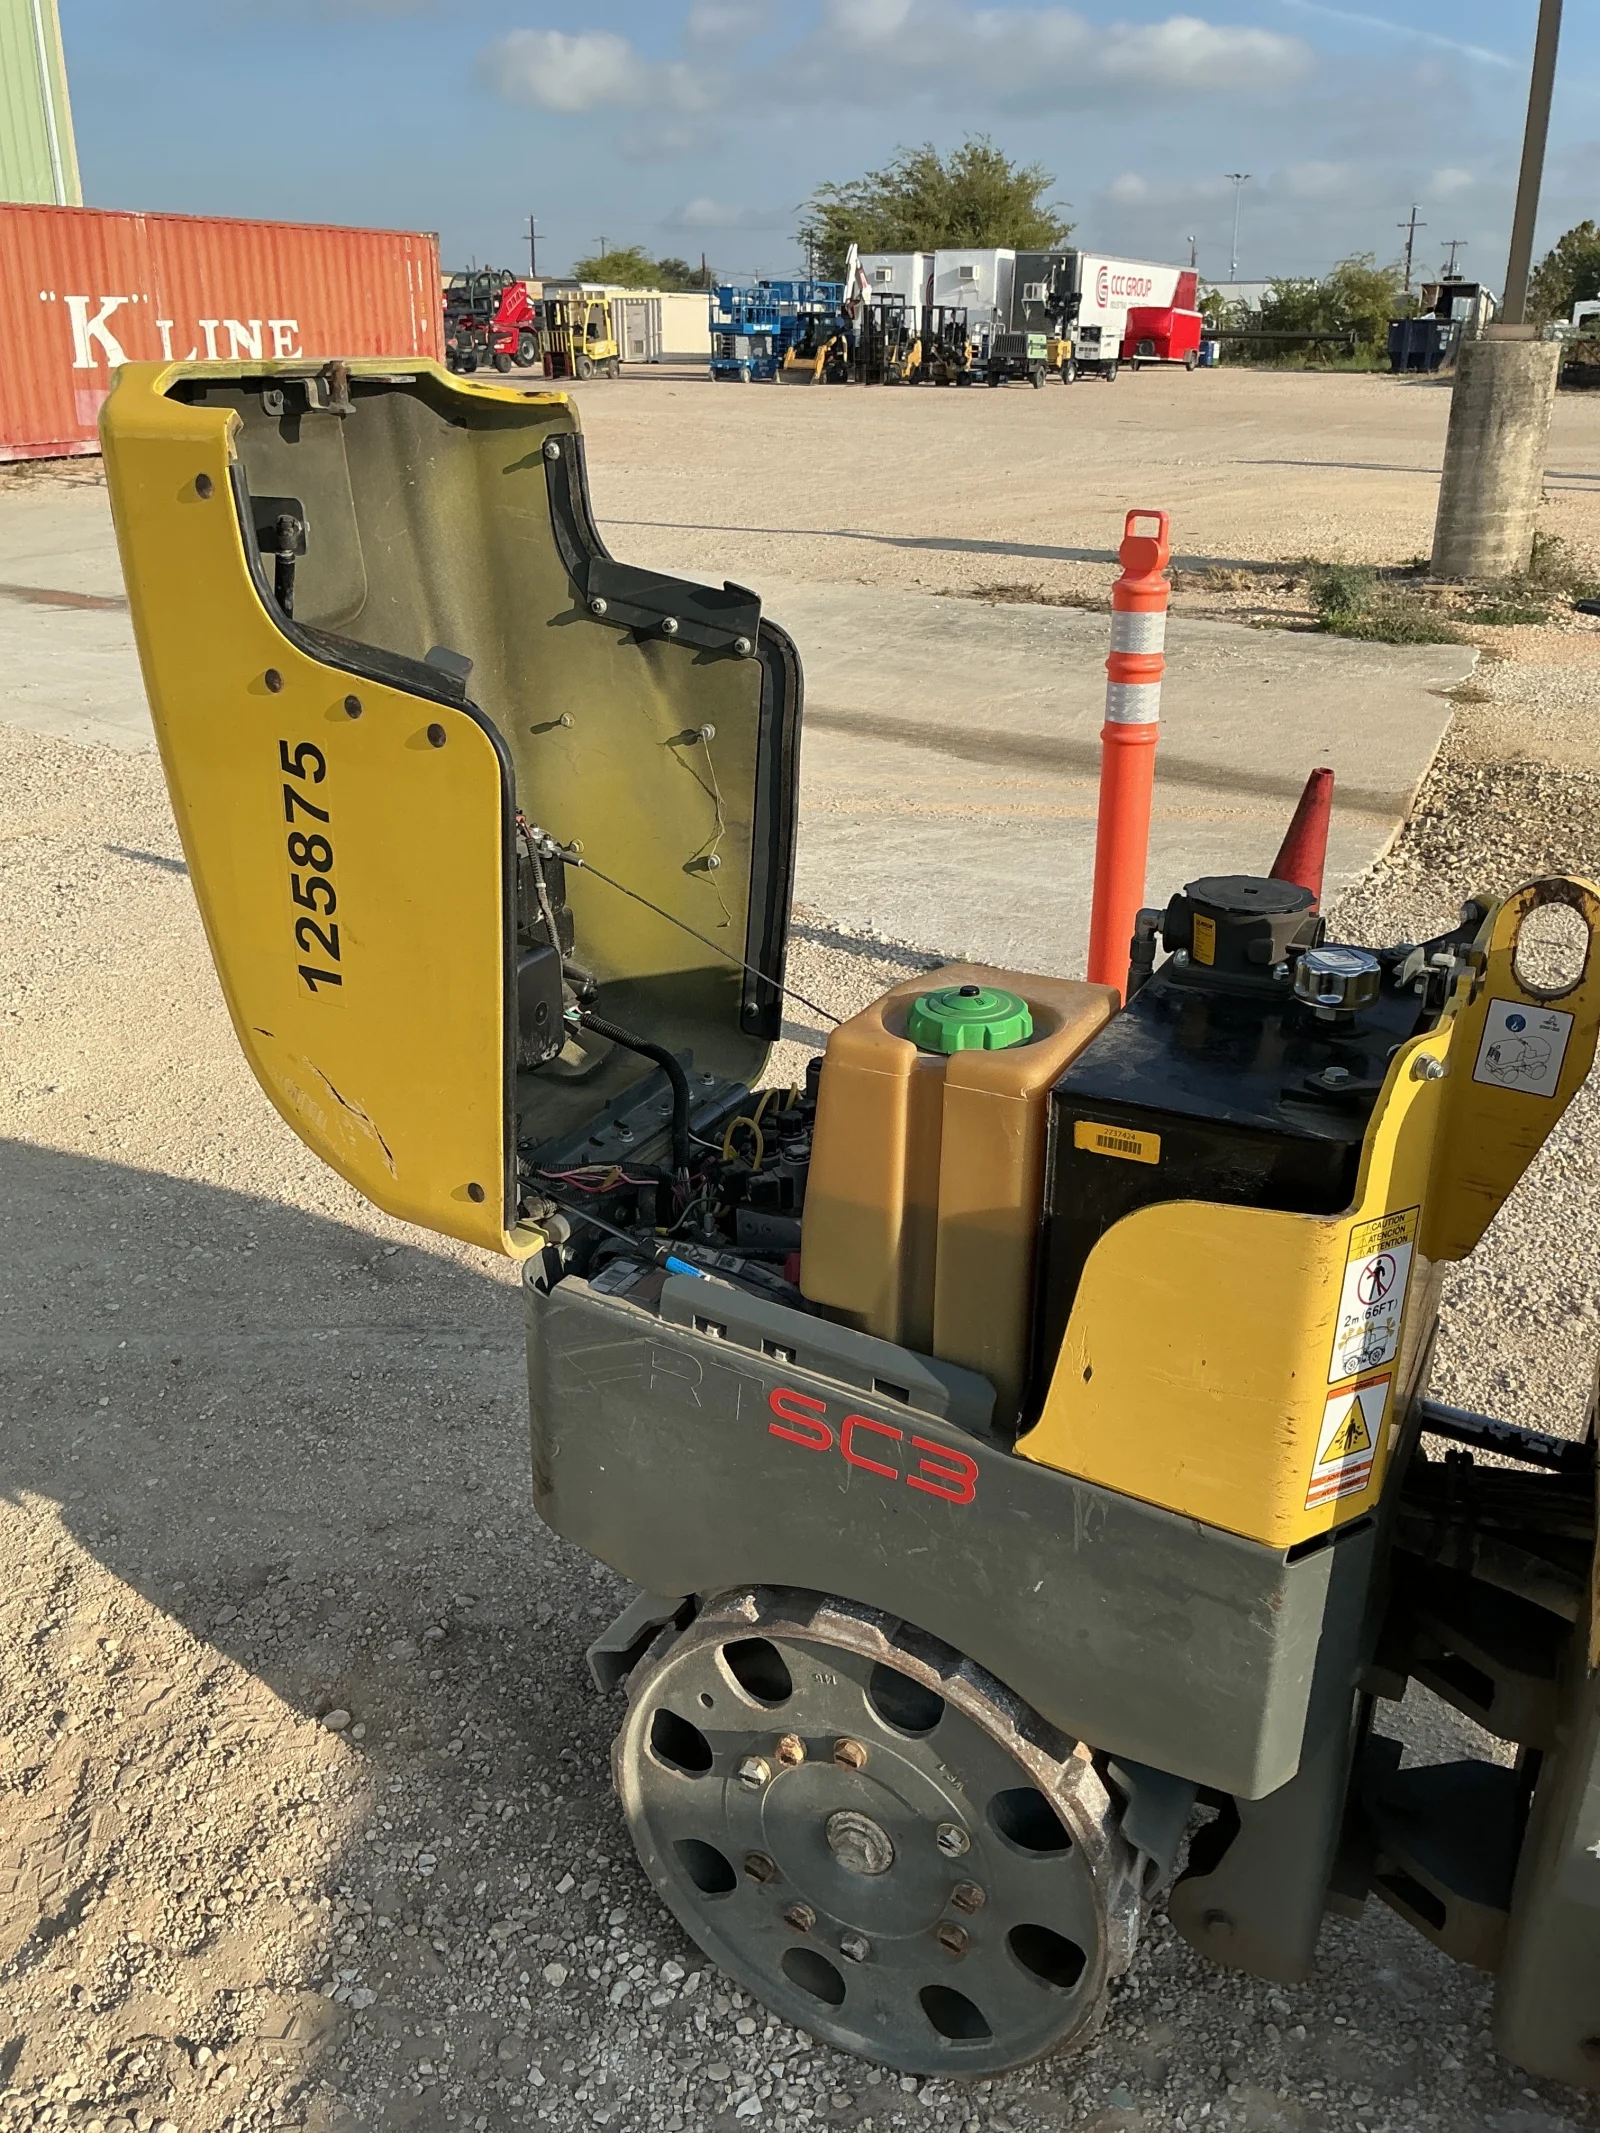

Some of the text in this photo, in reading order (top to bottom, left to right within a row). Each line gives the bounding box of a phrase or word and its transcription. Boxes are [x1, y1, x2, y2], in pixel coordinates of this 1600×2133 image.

[1111, 275, 1152, 297] CCC GROUP
[156, 319, 303, 361] LINE
[279, 739, 343, 993] 125875
[1104, 1128, 1136, 1140] 2737424
[1371, 1214, 1405, 1231] CAUTION
[1368, 1224, 1406, 1243] ATENCIÓN
[1366, 1234, 1408, 1255] ATTENTION
[769, 1388, 978, 1505] SC3
